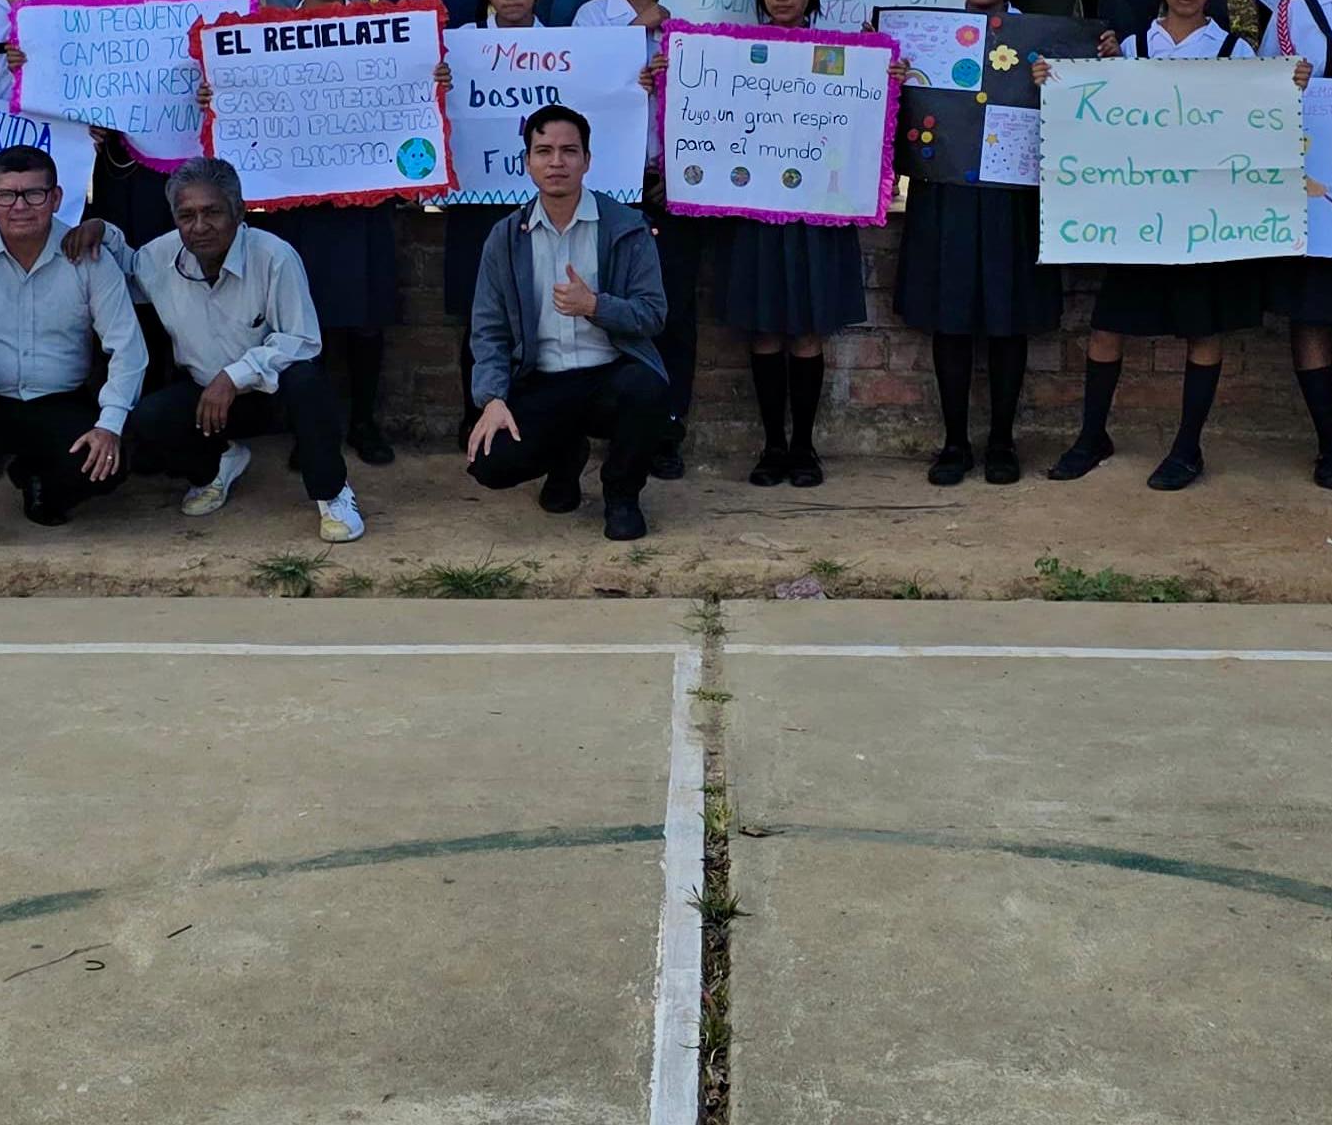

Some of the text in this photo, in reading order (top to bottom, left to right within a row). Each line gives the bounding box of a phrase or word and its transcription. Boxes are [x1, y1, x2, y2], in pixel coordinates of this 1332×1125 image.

[63, 9, 91, 33] UN
[216, 17, 410, 56] EL RECICLAJE
[60, 38, 150, 67] CAMBIO
[157, 68, 201, 95] RESP
[214, 57, 397, 88] EMPIEZA EN
[217, 81, 436, 114] CASA Y TERMIN
[469, 79, 562, 108] basura
[731, 75, 816, 101] pequeño
[823, 78, 882, 101] cambio
[129, 105, 148, 133] EL
[159, 105, 200, 132] MUN
[219, 107, 439, 141] EN UN PLANETA
[718, 109, 734, 122] un
[745, 109, 783, 133] gran
[793, 111, 848, 130] respiro
[1248, 108, 1284, 130] es
[676, 137, 715, 161] para
[730, 137, 747, 155] el
[1056, 155, 1199, 186] Sembrar
[1218, 154, 1284, 184] Paz
[1059, 220, 1116, 245] con
[1139, 212, 1163, 245] el
